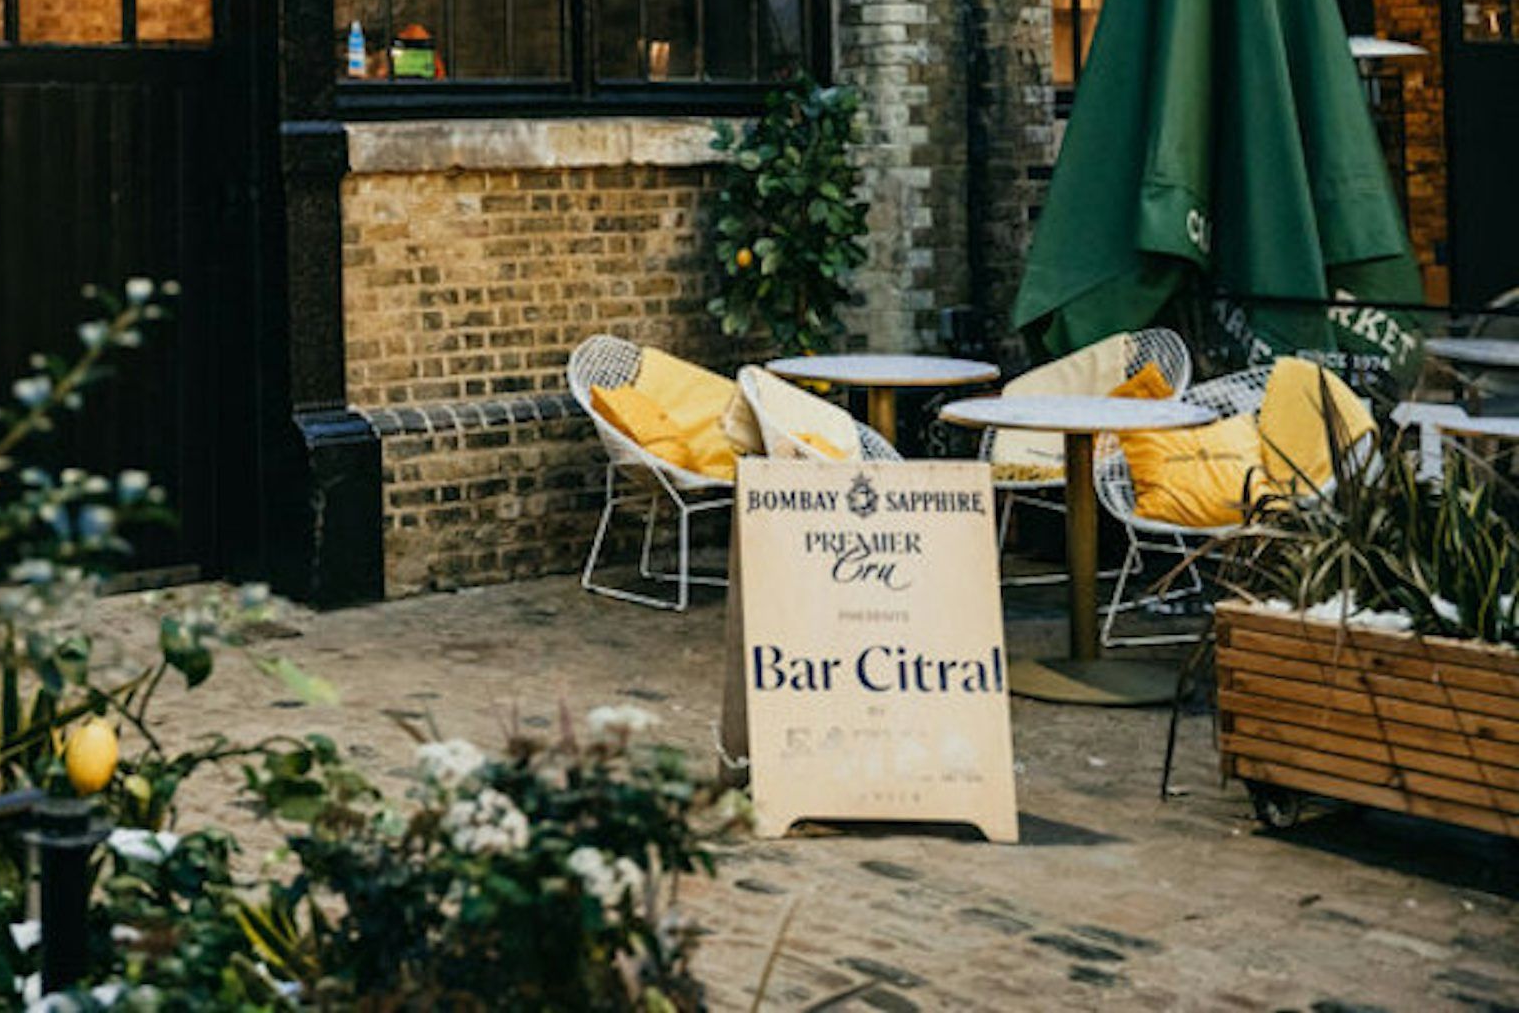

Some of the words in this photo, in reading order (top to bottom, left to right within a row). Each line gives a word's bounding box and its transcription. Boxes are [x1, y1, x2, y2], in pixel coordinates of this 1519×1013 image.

[746, 490, 839, 515] BOMBAY
[886, 490, 987, 516] SAPPHIRE
[805, 532, 922, 555] PREMIER
[832, 547, 911, 590] Cru
[753, 645, 841, 692] Bar
[856, 645, 1004, 693] Citral
